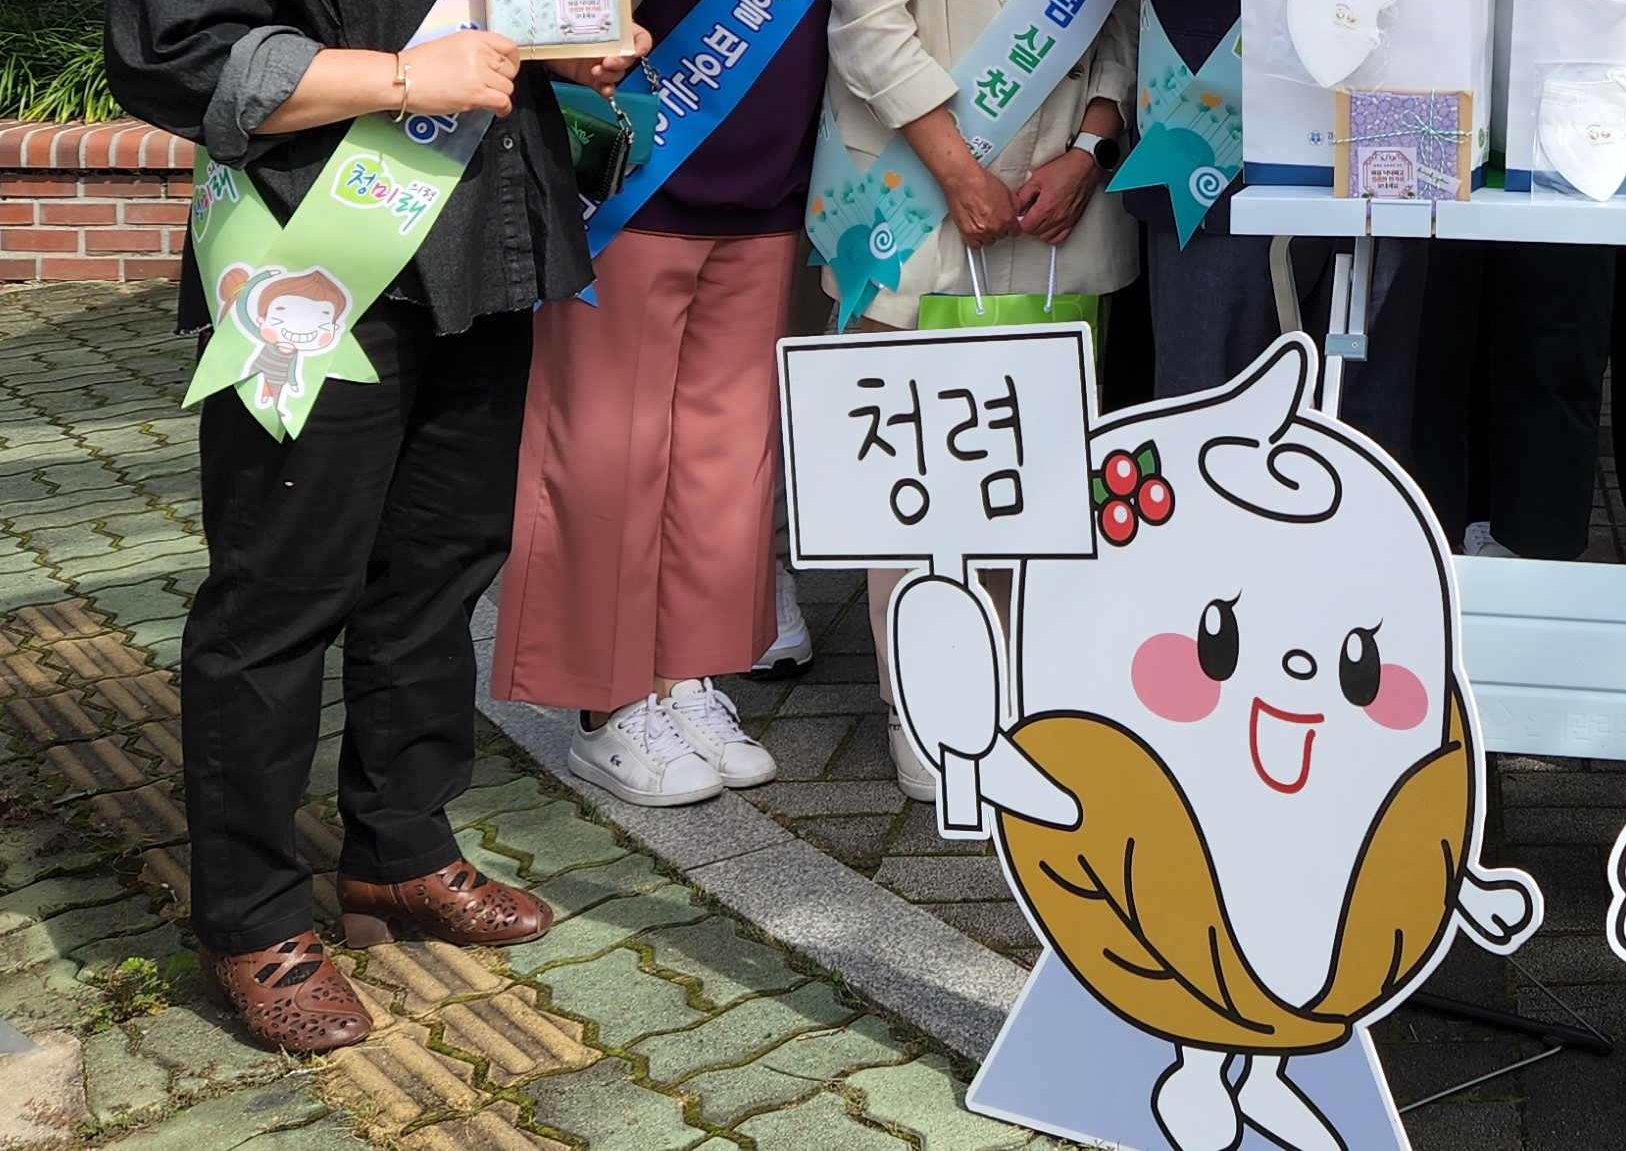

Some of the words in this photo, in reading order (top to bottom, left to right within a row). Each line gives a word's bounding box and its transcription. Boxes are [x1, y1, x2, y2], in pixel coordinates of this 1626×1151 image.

[974, 24, 1058, 119] 실천
[347, 164, 427, 233] 청미래
[848, 374, 1024, 526] 청렴
